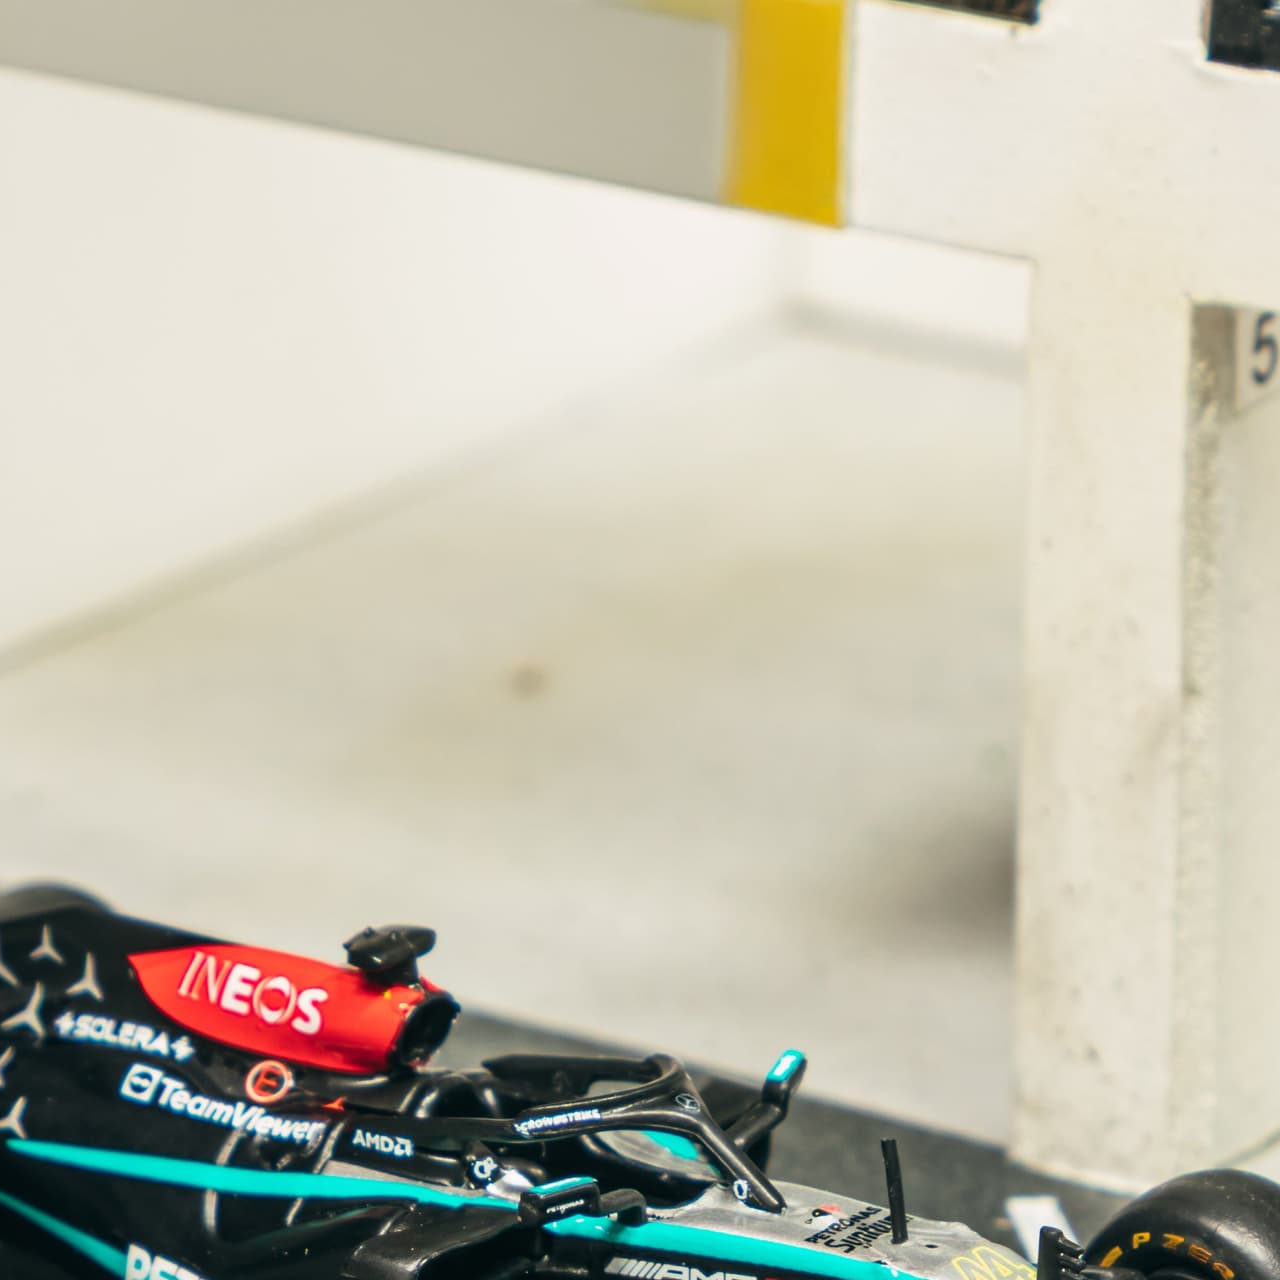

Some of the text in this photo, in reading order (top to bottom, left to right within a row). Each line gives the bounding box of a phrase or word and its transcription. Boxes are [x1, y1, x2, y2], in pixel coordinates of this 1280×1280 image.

[1252, 309, 1279, 386] 5
[177, 950, 329, 1036] INEOS
[73, 1013, 170, 1058] SOLERA
[156, 1076, 326, 1144] TeamViewer
[352, 1128, 395, 1157] AMD
[804, 1205, 883, 1244] PETRONAS
[823, 1214, 894, 1254] Syntiu
